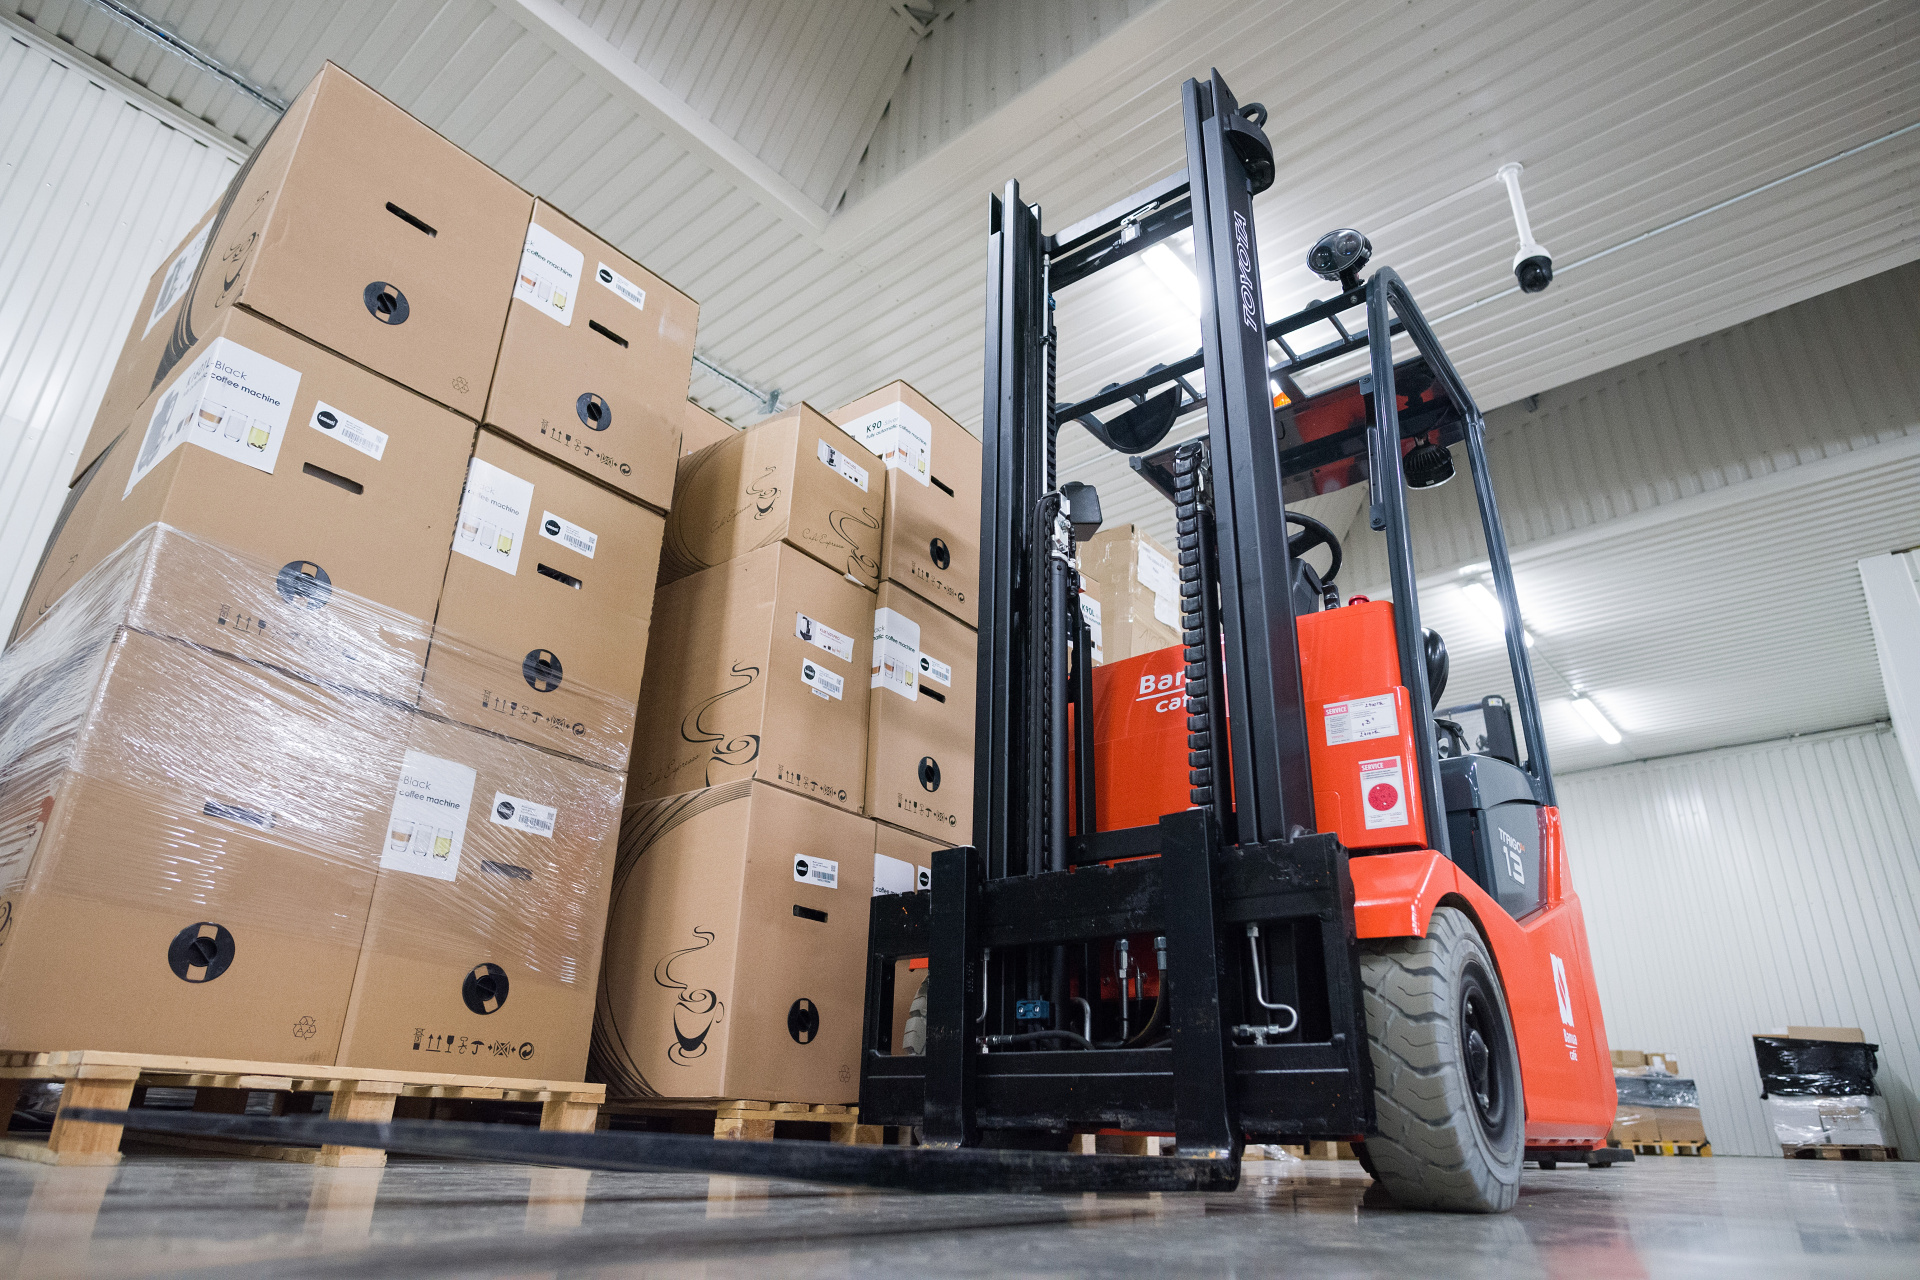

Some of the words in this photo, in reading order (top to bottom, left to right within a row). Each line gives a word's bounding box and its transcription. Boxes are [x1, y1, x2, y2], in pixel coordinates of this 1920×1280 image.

[526, 248, 546, 262] coffee
[546, 259, 573, 279] machine
[1234, 210, 1257, 332] TOYOTA
[211, 372, 239, 389] coffee
[241, 385, 281, 407] machine
[866, 420, 882, 433] K90
[490, 499, 520, 516] machine
[885, 634, 899, 645] coffee
[898, 641, 916, 654] machine
[1155, 693, 1194, 713] caf
[1325, 705, 1348, 716] SERVICE
[1361, 762, 1384, 772] SERVICE
[399, 790, 425, 802] coffee
[426, 795, 461, 810] machine
[1503, 846, 1525, 885] 13
